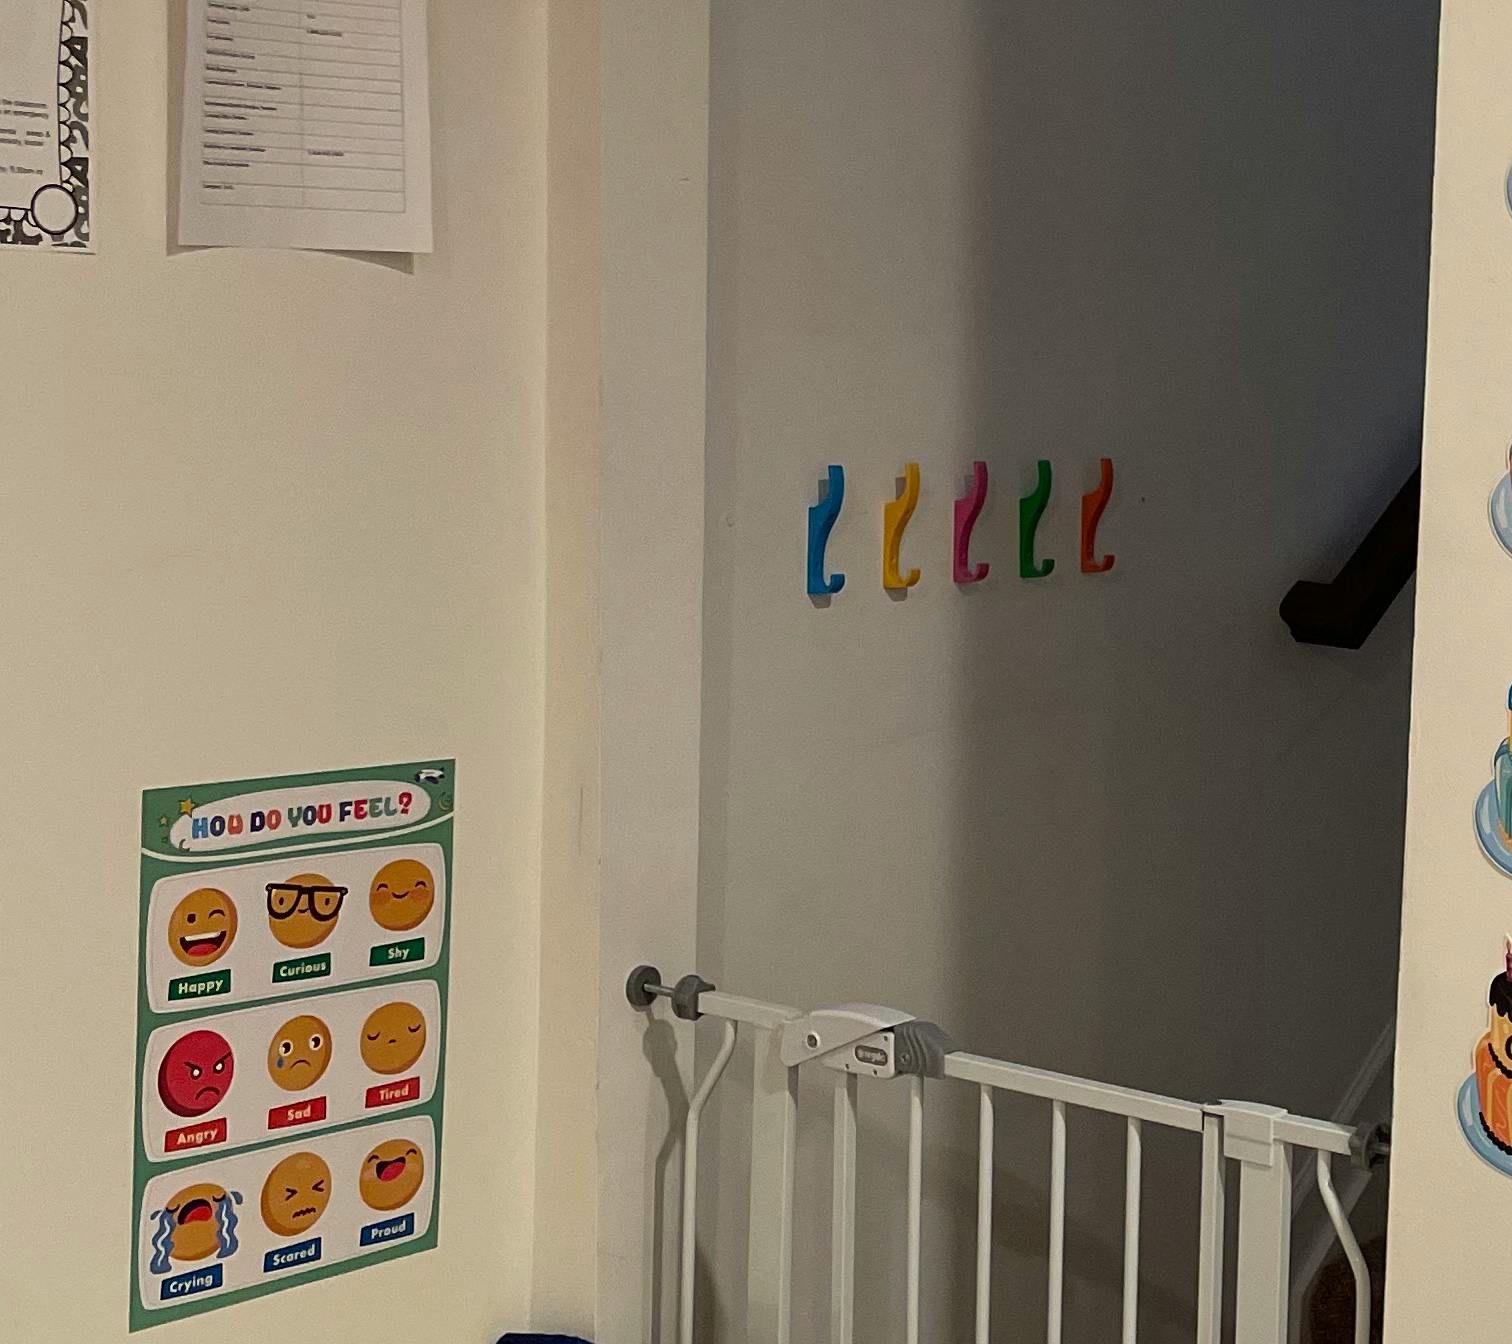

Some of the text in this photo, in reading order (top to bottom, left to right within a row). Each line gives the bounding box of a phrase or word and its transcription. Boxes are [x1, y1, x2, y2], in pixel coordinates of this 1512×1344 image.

[250, 809, 282, 833] DO
[287, 803, 332, 828] YOU
[338, 791, 413, 823] FEEL?
[387, 946, 410, 961] Shy
[279, 959, 327, 978] Curious
[178, 977, 224, 997] Happy
[378, 1085, 410, 1102] Tired
[286, 1105, 312, 1121] Sad
[177, 1127, 219, 1147] Angry
[370, 1220, 407, 1240] Proud
[272, 1244, 316, 1266] Scared
[169, 1274, 214, 1294] Crying
